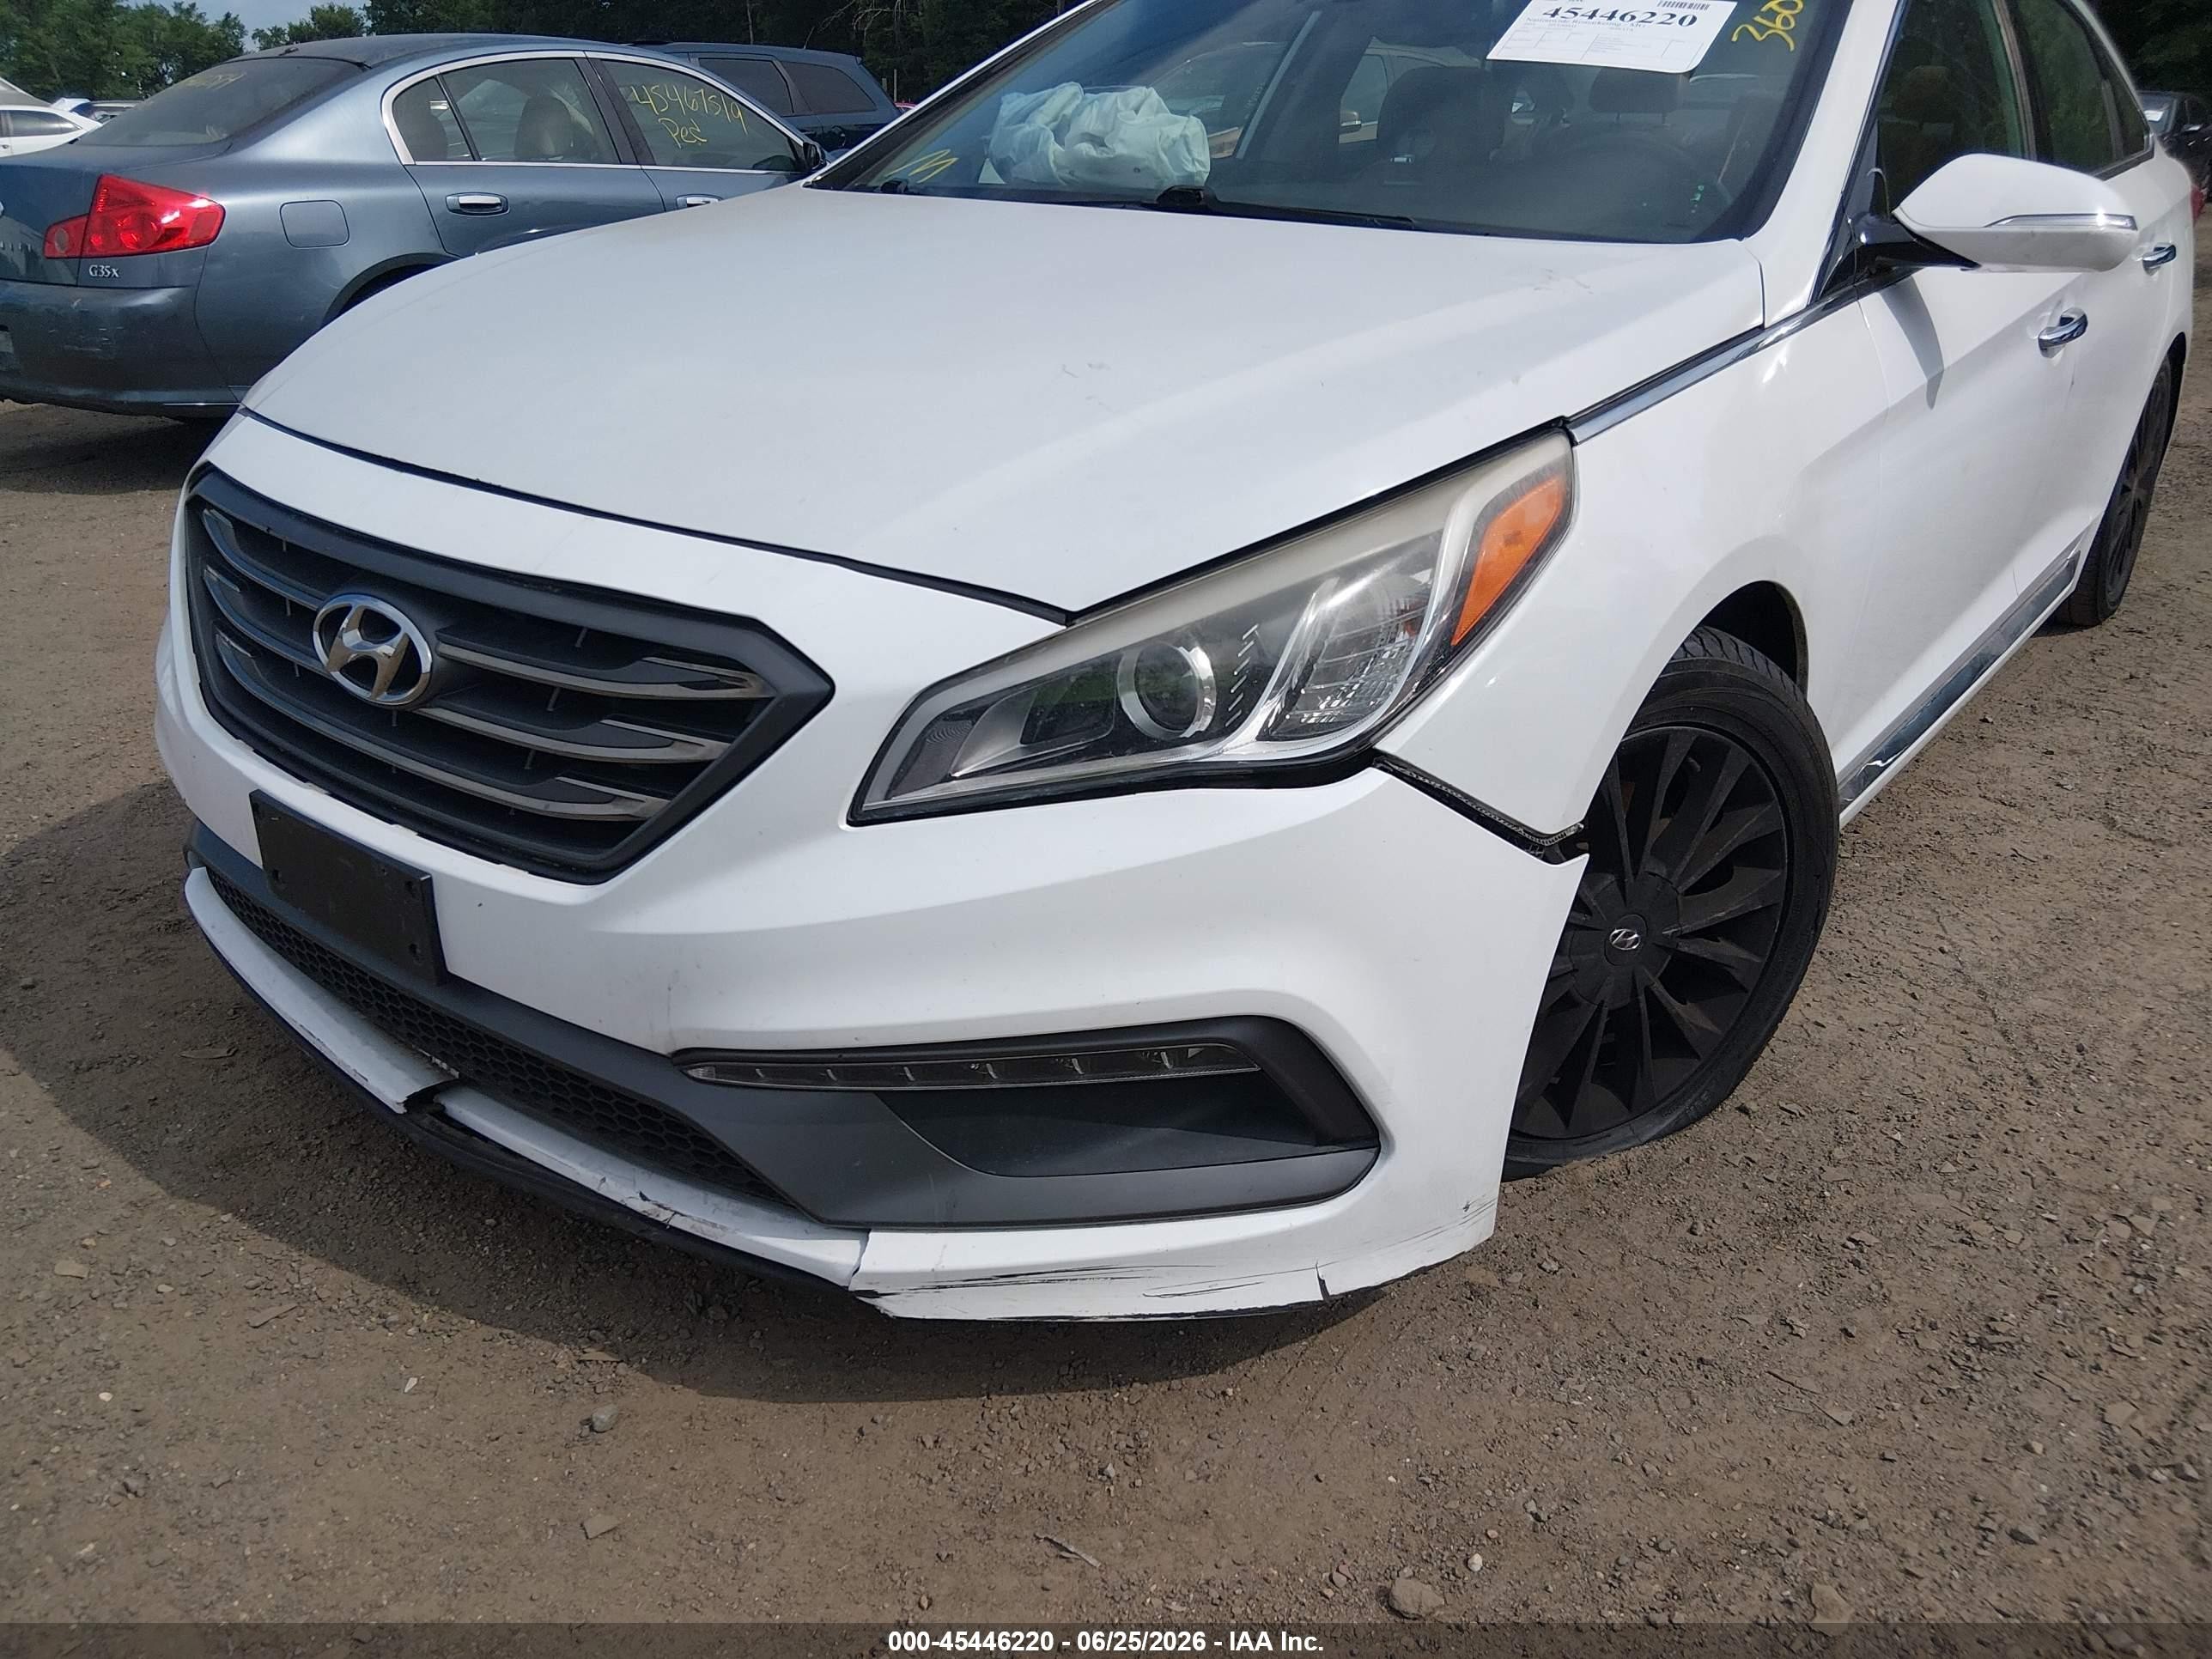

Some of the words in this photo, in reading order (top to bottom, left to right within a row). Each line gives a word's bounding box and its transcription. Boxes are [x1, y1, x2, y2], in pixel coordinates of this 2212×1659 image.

[1542, 6, 1698, 27] 45446220
[630, 85, 749, 136] 45467519
[88, 264, 119, 277] G35x
